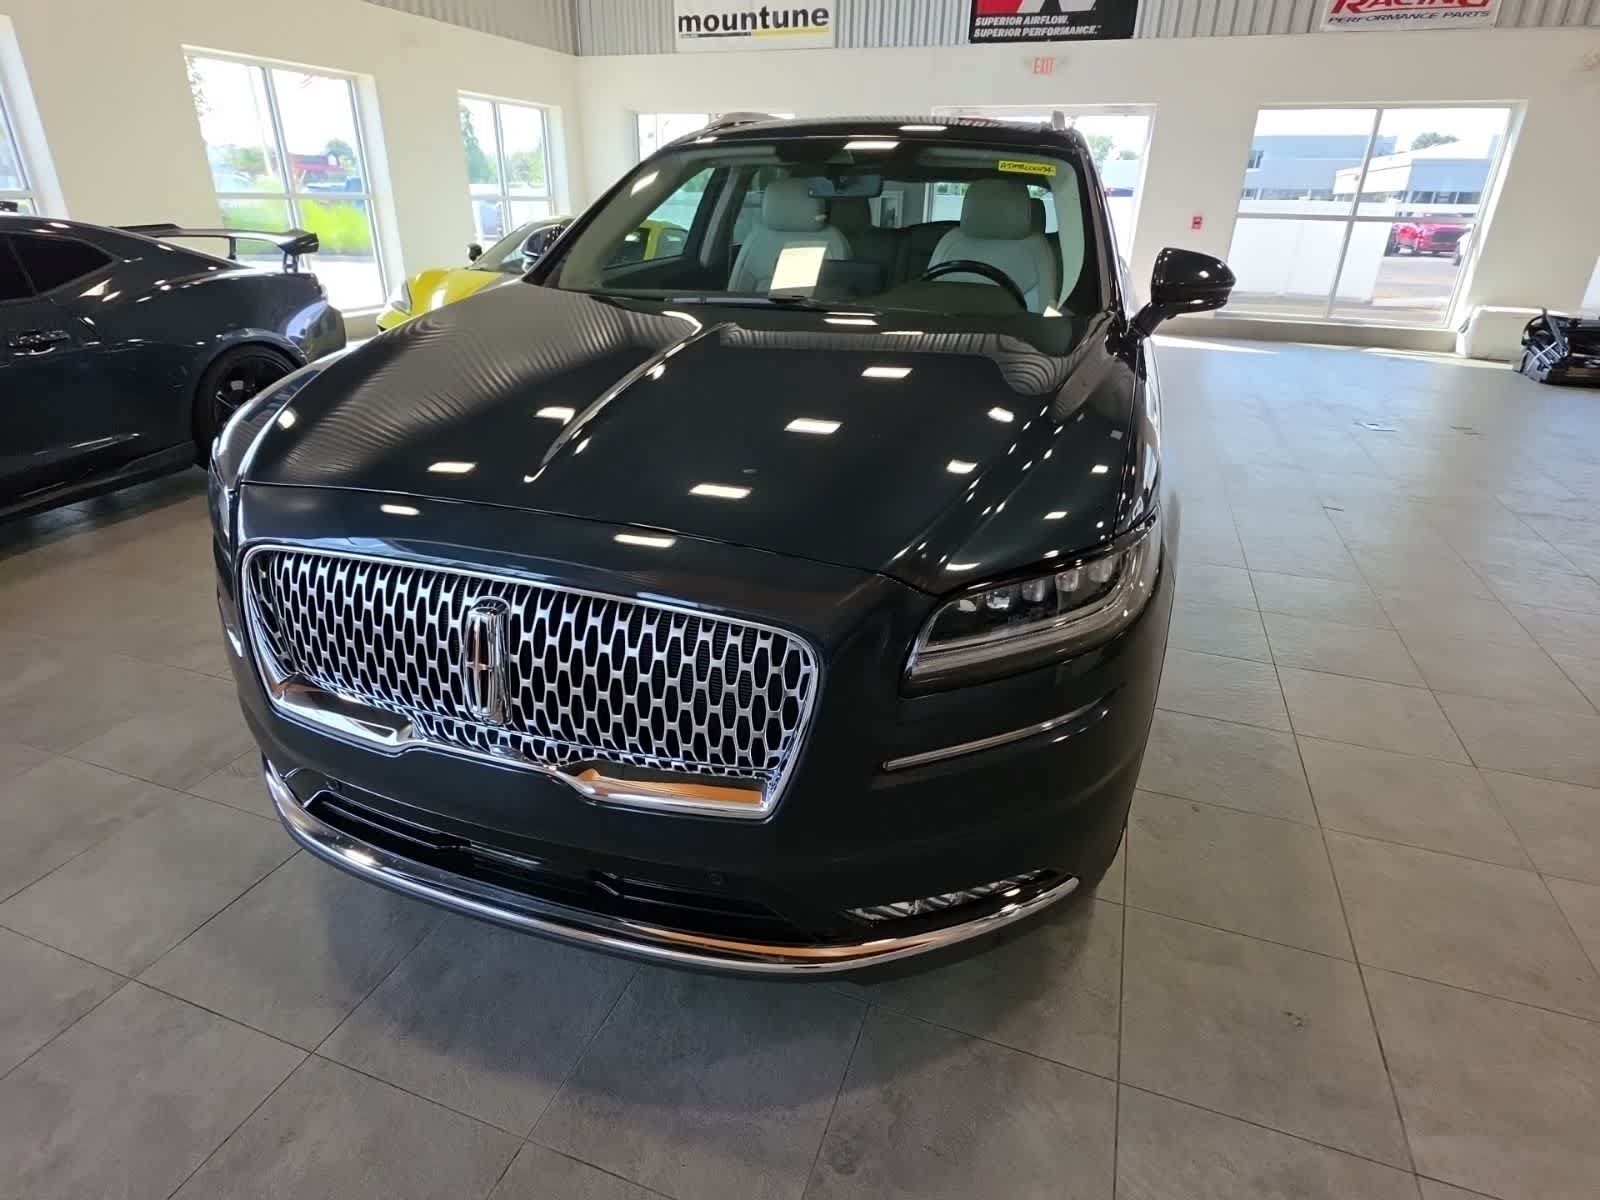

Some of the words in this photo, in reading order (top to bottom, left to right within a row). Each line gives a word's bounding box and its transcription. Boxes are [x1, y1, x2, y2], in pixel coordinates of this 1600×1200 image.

[678, 5, 830, 33] mountune
[975, 16, 1023, 26] SUPERIOR
[1328, 12, 1440, 23] PERFORMANCE
[1442, 10, 1489, 18] PARTS
[974, 27, 1022, 38] SUPERIOR
[1033, 57, 1054, 74] EXIT
